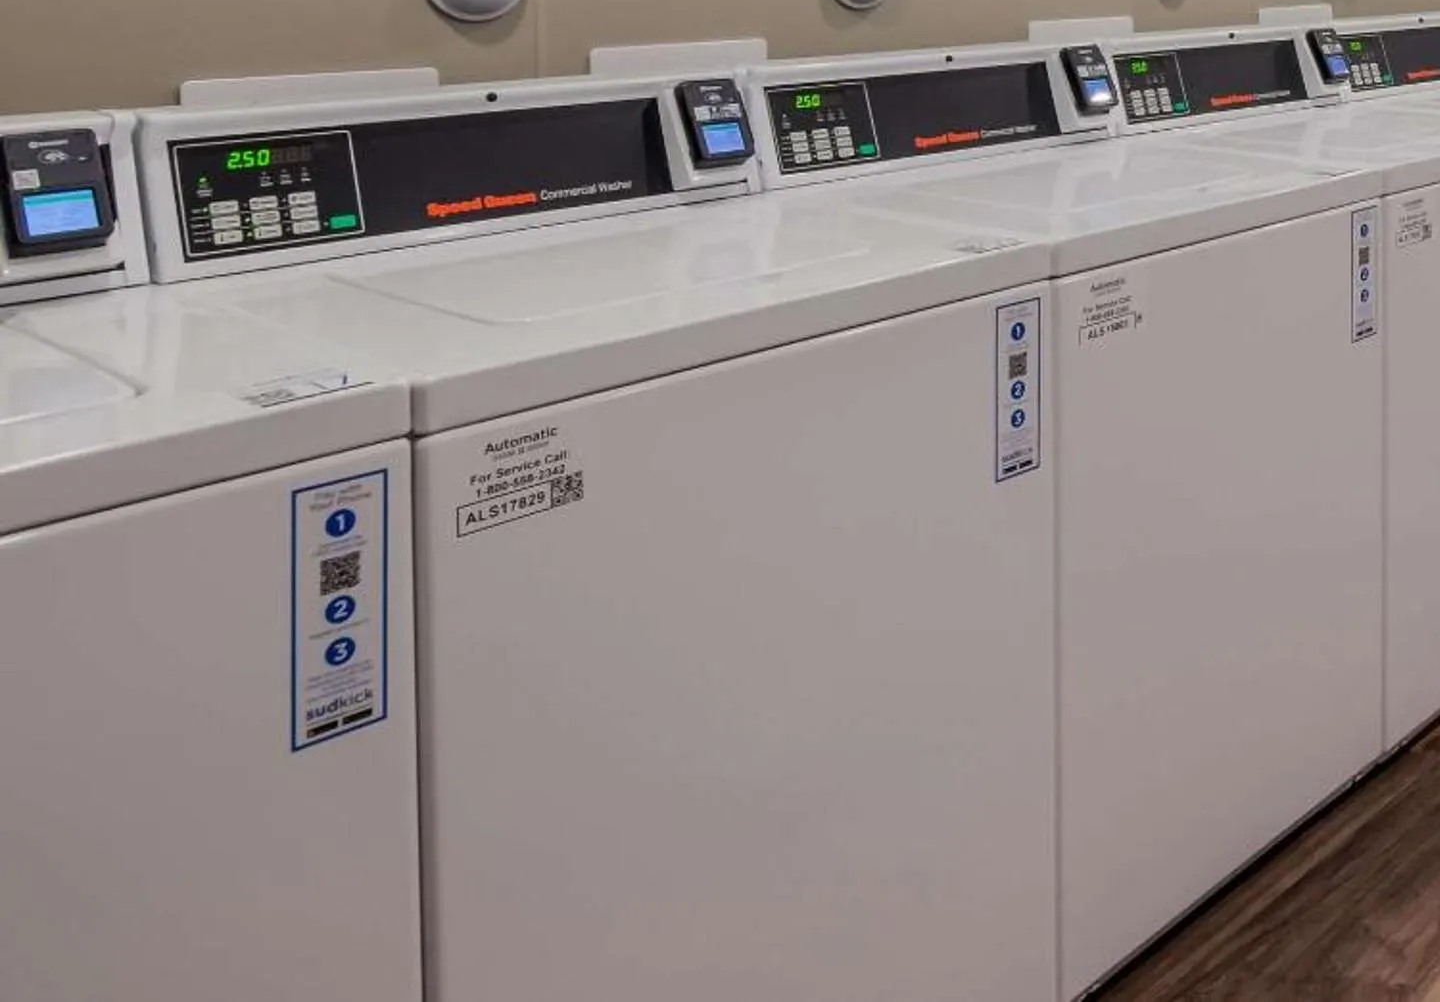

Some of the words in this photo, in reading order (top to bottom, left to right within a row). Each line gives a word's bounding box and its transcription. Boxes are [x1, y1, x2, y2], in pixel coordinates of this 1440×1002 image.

[427, 197, 482, 217] Speed
[540, 183, 597, 201] Commercial
[598, 179, 633, 194] Washer
[484, 426, 559, 455] Automatic
[470, 473, 492, 486] For
[496, 459, 541, 479] Service
[544, 450, 568, 464] Call
[465, 491, 546, 526] ALS17829
[333, 599, 348, 619] 2
[333, 641, 348, 662] 3
[306, 688, 373, 721] sudkick
